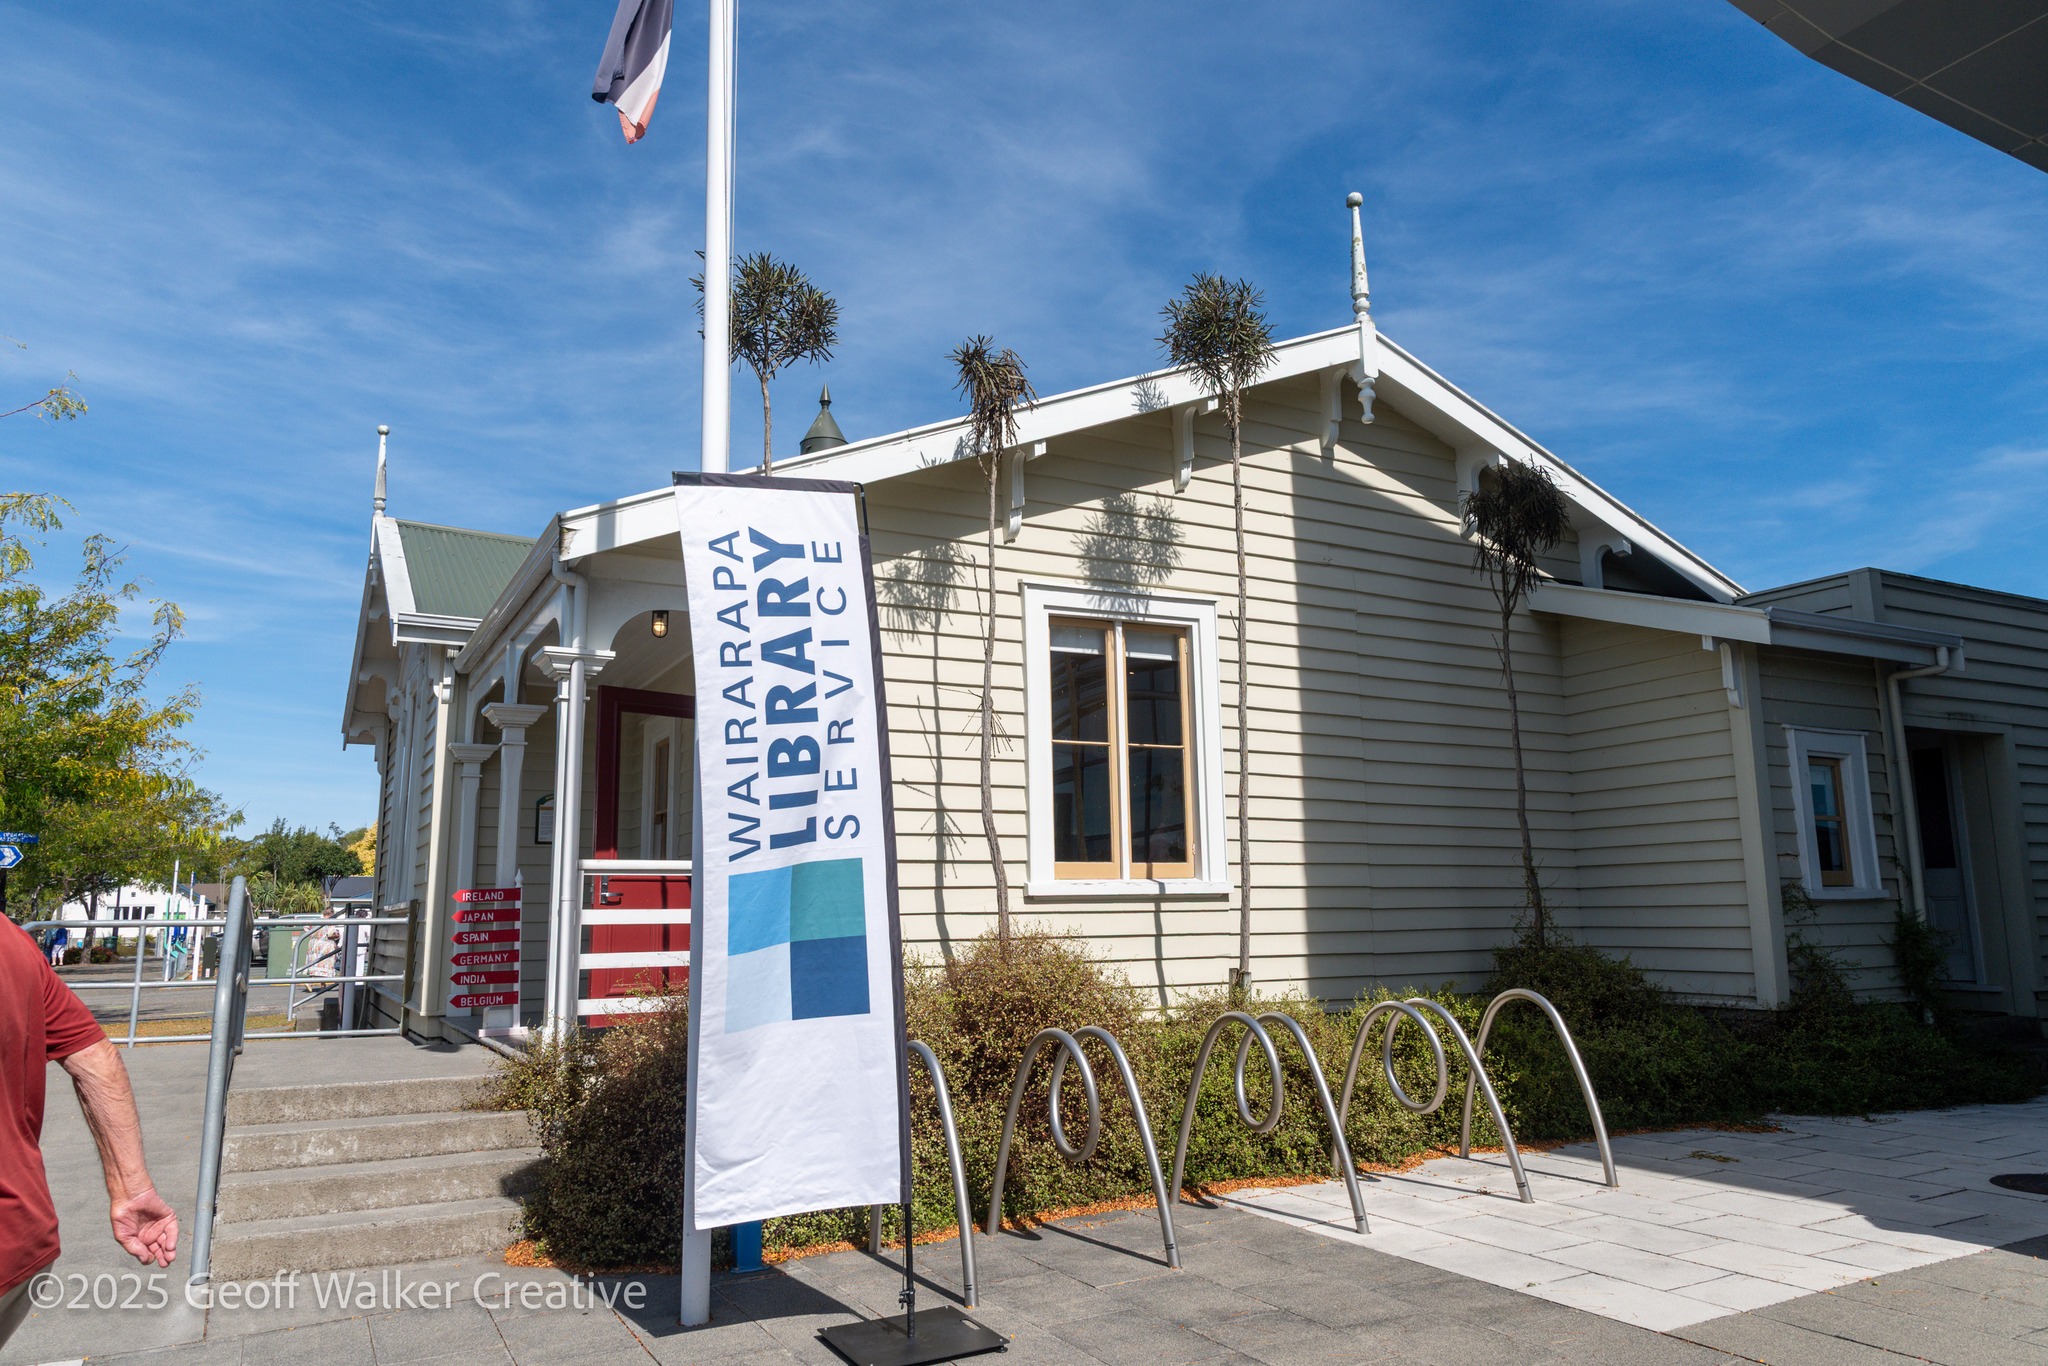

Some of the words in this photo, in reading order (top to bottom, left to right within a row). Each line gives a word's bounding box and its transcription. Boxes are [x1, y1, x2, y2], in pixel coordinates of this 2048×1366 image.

[748, 526, 821, 850] LIBRARY
[811, 540, 861, 840] SERVICE
[708, 530, 761, 863] WAIRARAPA
[462, 891, 504, 902] IRELAND
[462, 912, 494, 923] JAPAN
[462, 932, 489, 943] SPAIN
[460, 953, 509, 965] GERMANY
[460, 974, 487, 985] INDIA
[460, 995, 504, 1007] BELGIUM
